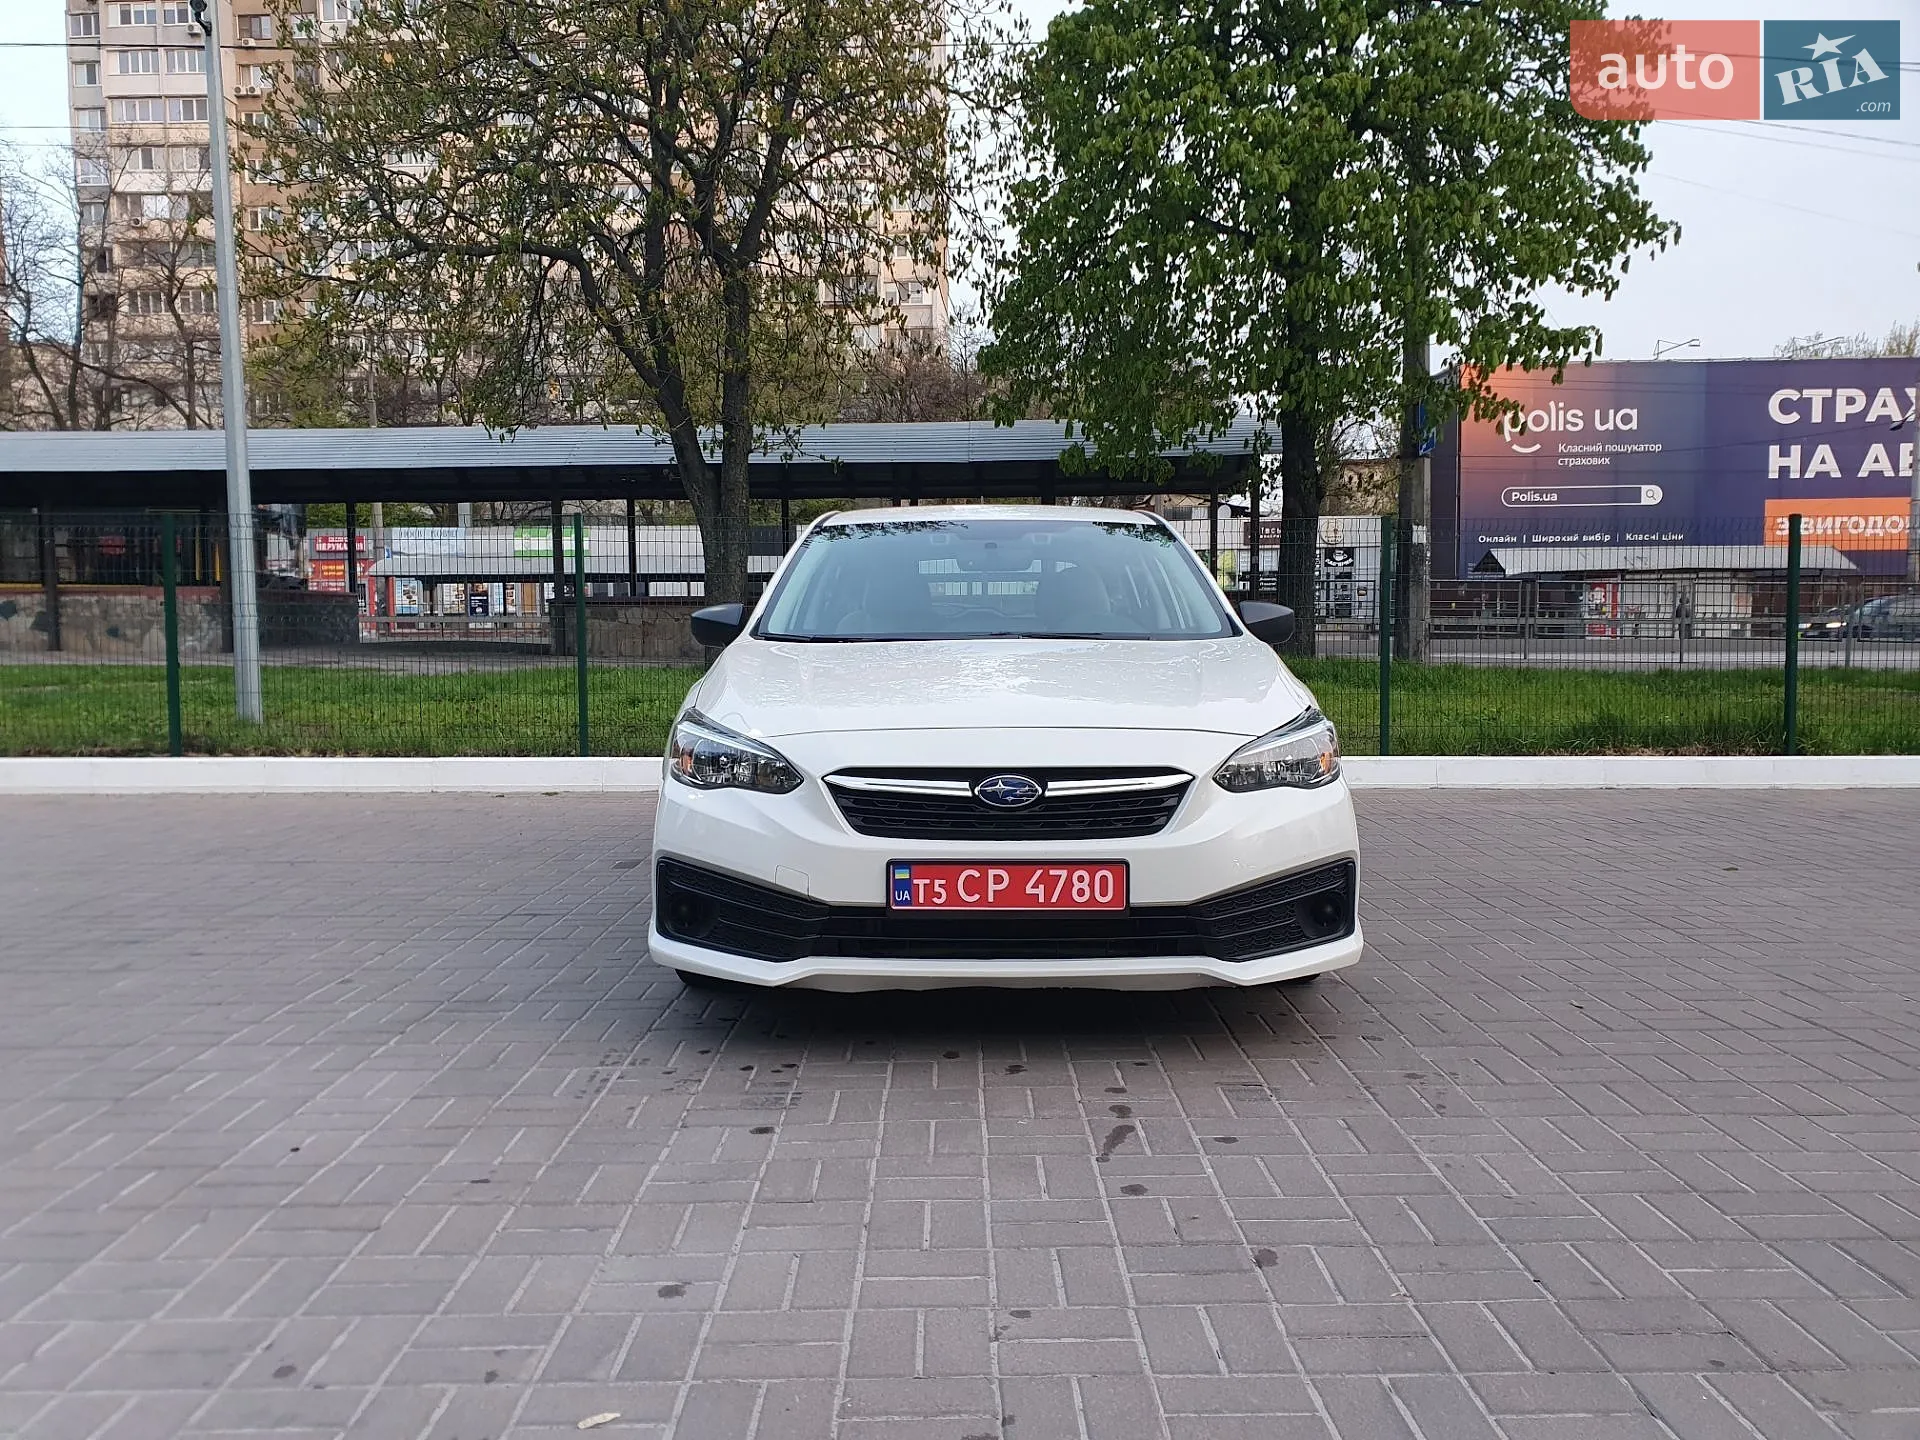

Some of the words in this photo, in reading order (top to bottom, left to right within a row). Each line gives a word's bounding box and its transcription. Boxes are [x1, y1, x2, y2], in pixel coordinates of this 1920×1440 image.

[1504, 400, 1584, 442] polis
[1594, 408, 1638, 431] ua
[1558, 442, 1602, 453] Класний
[1605, 442, 1662, 453] пошукатор
[1558, 456, 1610, 467] страхових
[1768, 444, 1842, 479] НА
[1511, 491, 1558, 502] Polis.ua
[1800, 515, 1910, 537] ВИГОДО
[1478, 534, 1517, 543] Онлайн
[1532, 533, 1579, 543] Широкий
[1582, 533, 1611, 542] вибір
[1626, 532, 1659, 541] Класні
[1662, 532, 1684, 541] ціни
[895, 890, 911, 901] UA
[913, 879, 947, 904] T5
[957, 869, 1010, 903] CP
[1025, 869, 1114, 903] 4780
